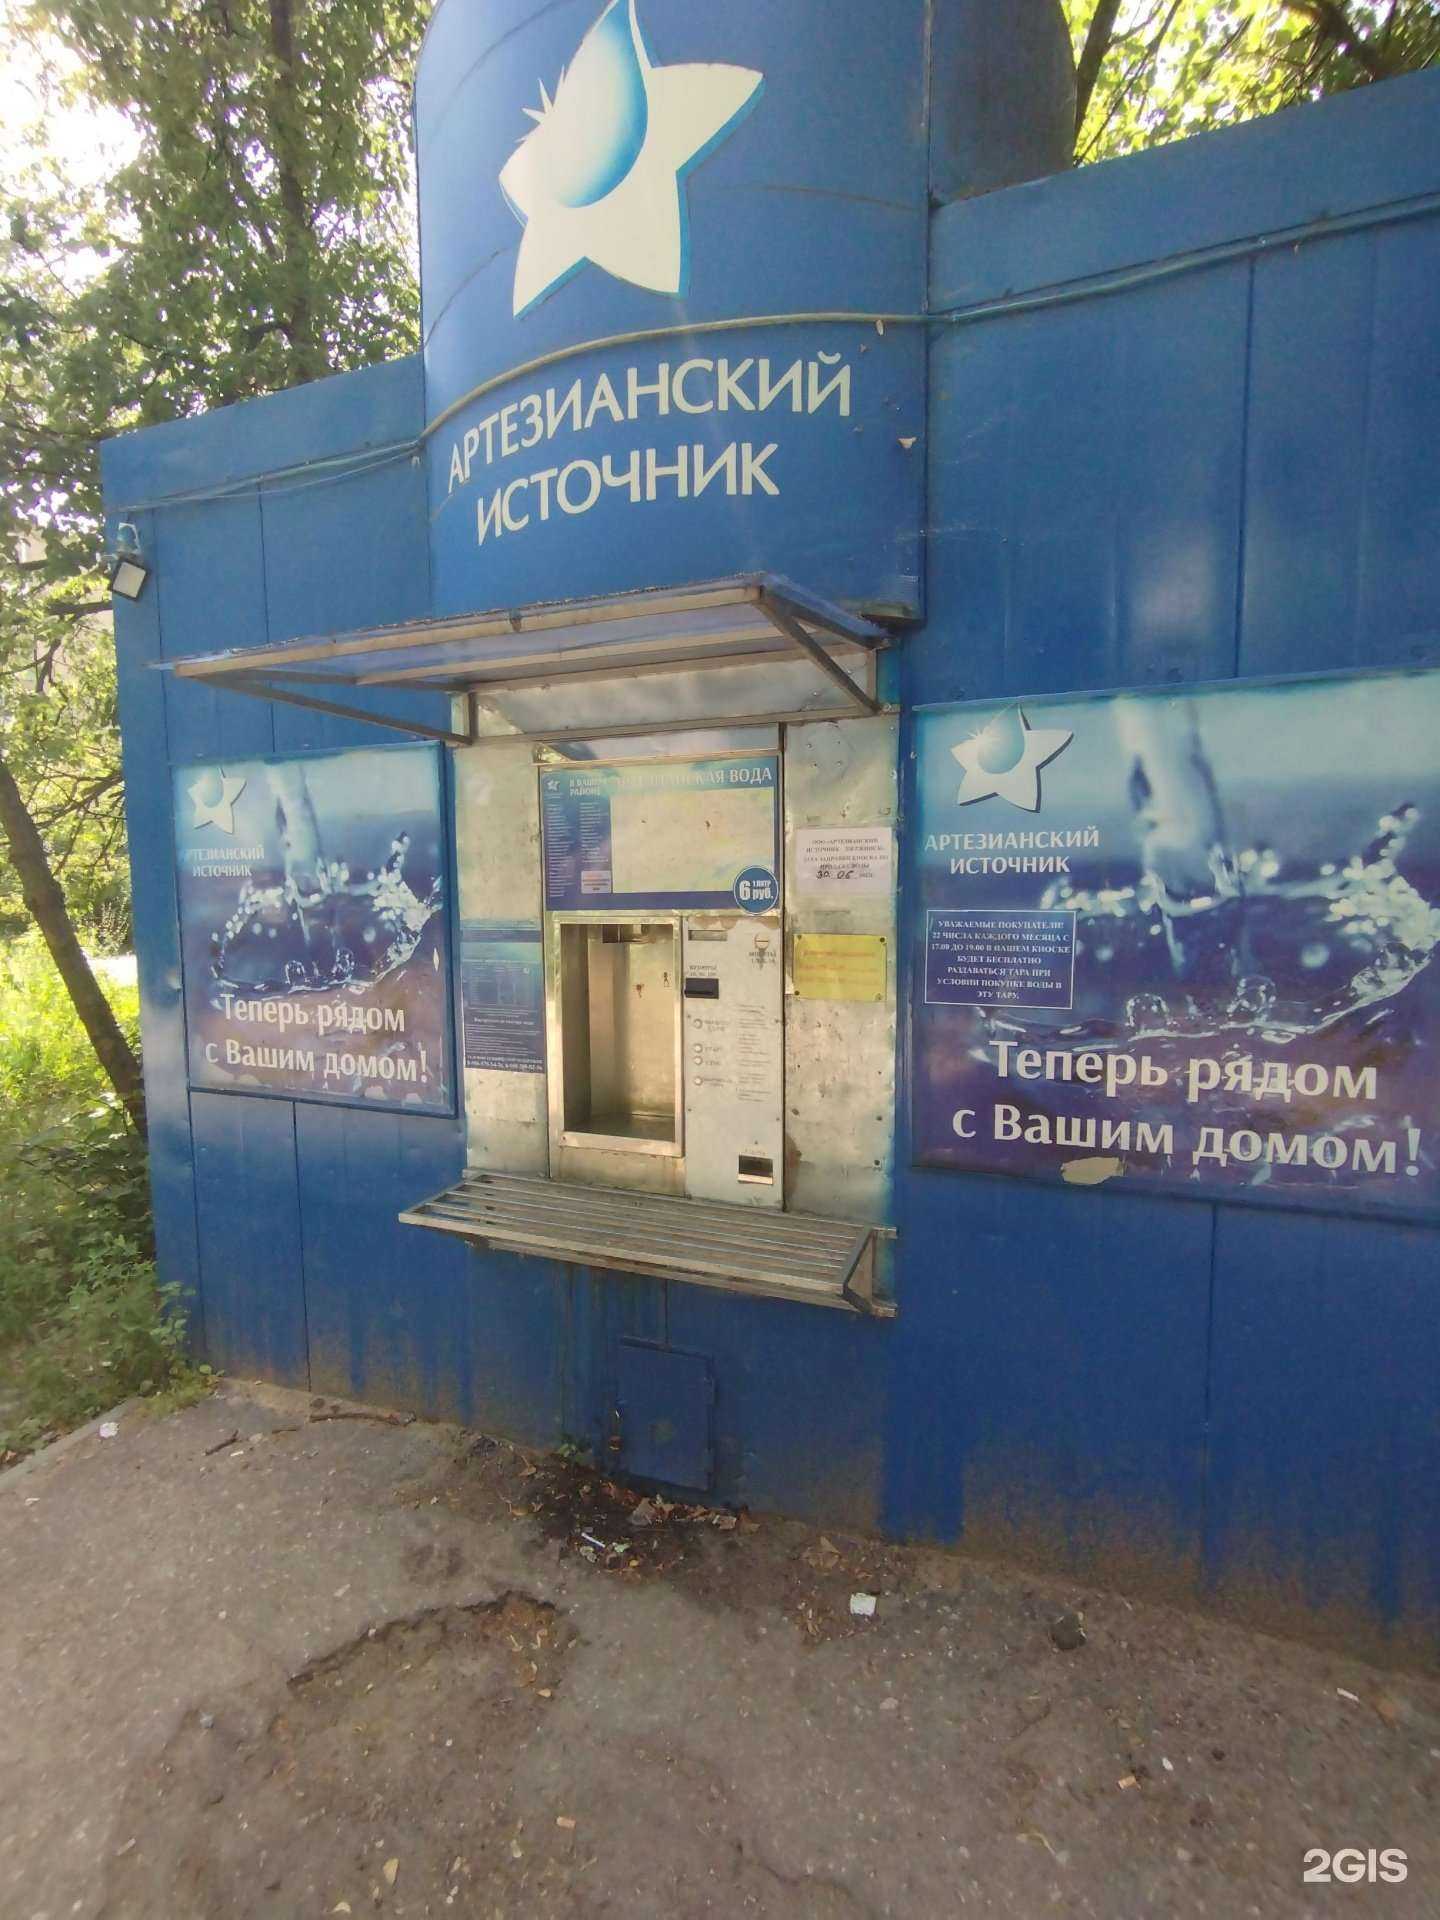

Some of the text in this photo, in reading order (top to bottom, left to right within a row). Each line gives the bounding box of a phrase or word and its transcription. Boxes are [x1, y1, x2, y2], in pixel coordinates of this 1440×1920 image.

[447, 350, 851, 494] АРТЕЗИАНСКИЙ
[476, 441, 780, 546] ИСТОЧНИК
[730, 767, 772, 785] ВОДА
[924, 825, 1099, 851] АРТЕЗИАНСКИЙ
[192, 863, 253, 877] ИСТОЧНИК
[950, 856, 1071, 874] ИСТОЧНИК
[740, 880, 774, 901] 6 руб.
[939, 920, 996, 929] УВАЖАЕМЫЕ
[942, 932, 974, 940] ЧИСЛА
[975, 932, 1020, 941] КАЖДОГО
[1021, 934, 1060, 942] МЕСЯЦА
[1031, 945, 1071, 953] КИОСКЕ
[957, 955, 1042, 964] БУДЕТ БЕСПЛАТНО
[947, 966, 1051, 977] РАЗДАВАТЬСЯ ТАРА ПРИ
[977, 990, 994, 998] ЭТУ
[1026, 981, 1054, 989] ВОДЫ
[220, 993, 405, 1036] Теперь рядом
[205, 1039, 429, 1083] с Вашим домом!
[989, 1040, 1376, 1103] Теперь рядом
[952, 1104, 1421, 1177] с Вашим домом!
